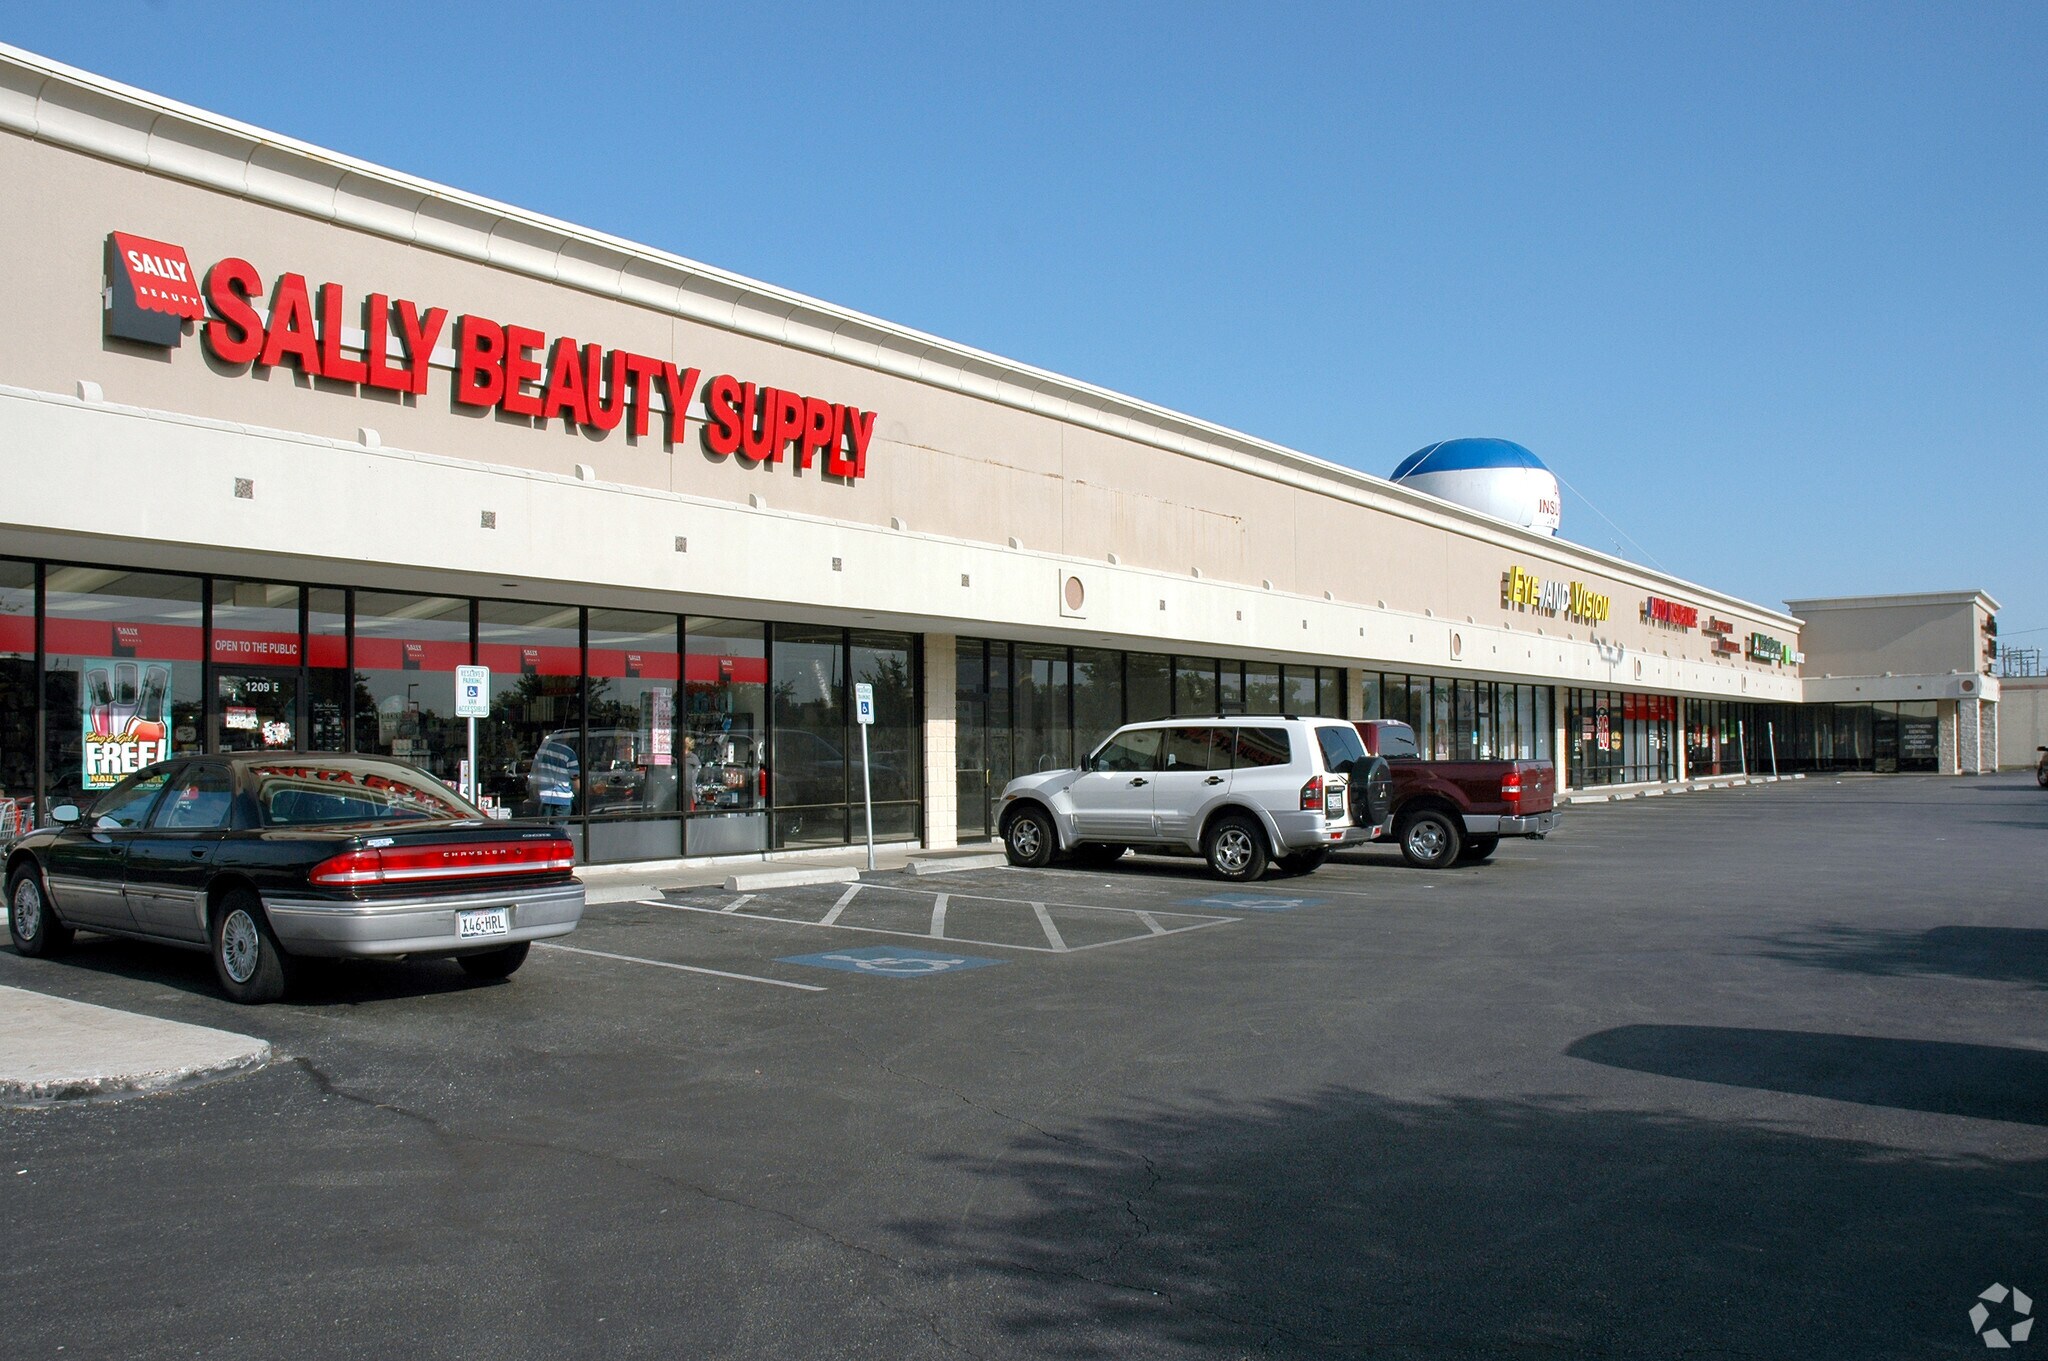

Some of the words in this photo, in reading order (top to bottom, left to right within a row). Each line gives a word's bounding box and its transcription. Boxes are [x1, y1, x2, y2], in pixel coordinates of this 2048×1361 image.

[127, 249, 188, 283] SALLY
[140, 286, 198, 306] BEAUTY
[205, 257, 448, 395] SALLY
[456, 313, 702, 444] BEAUTY
[703, 373, 877, 479] SUPPLY
[1509, 565, 1539, 606] EYE
[1540, 580, 1571, 612] AND
[1570, 581, 1611, 622] VISION
[117, 626, 139, 636] SALLY
[214, 639, 239, 652] OPEN
[239, 641, 251, 653] TO
[252, 641, 268, 653] THE
[269, 643, 298, 655] PUBLIC
[245, 682, 270, 693] 1209
[273, 682, 280, 693] E
[90, 774, 116, 783] NAIL
[443, 849, 507, 858] CHRYSLER
